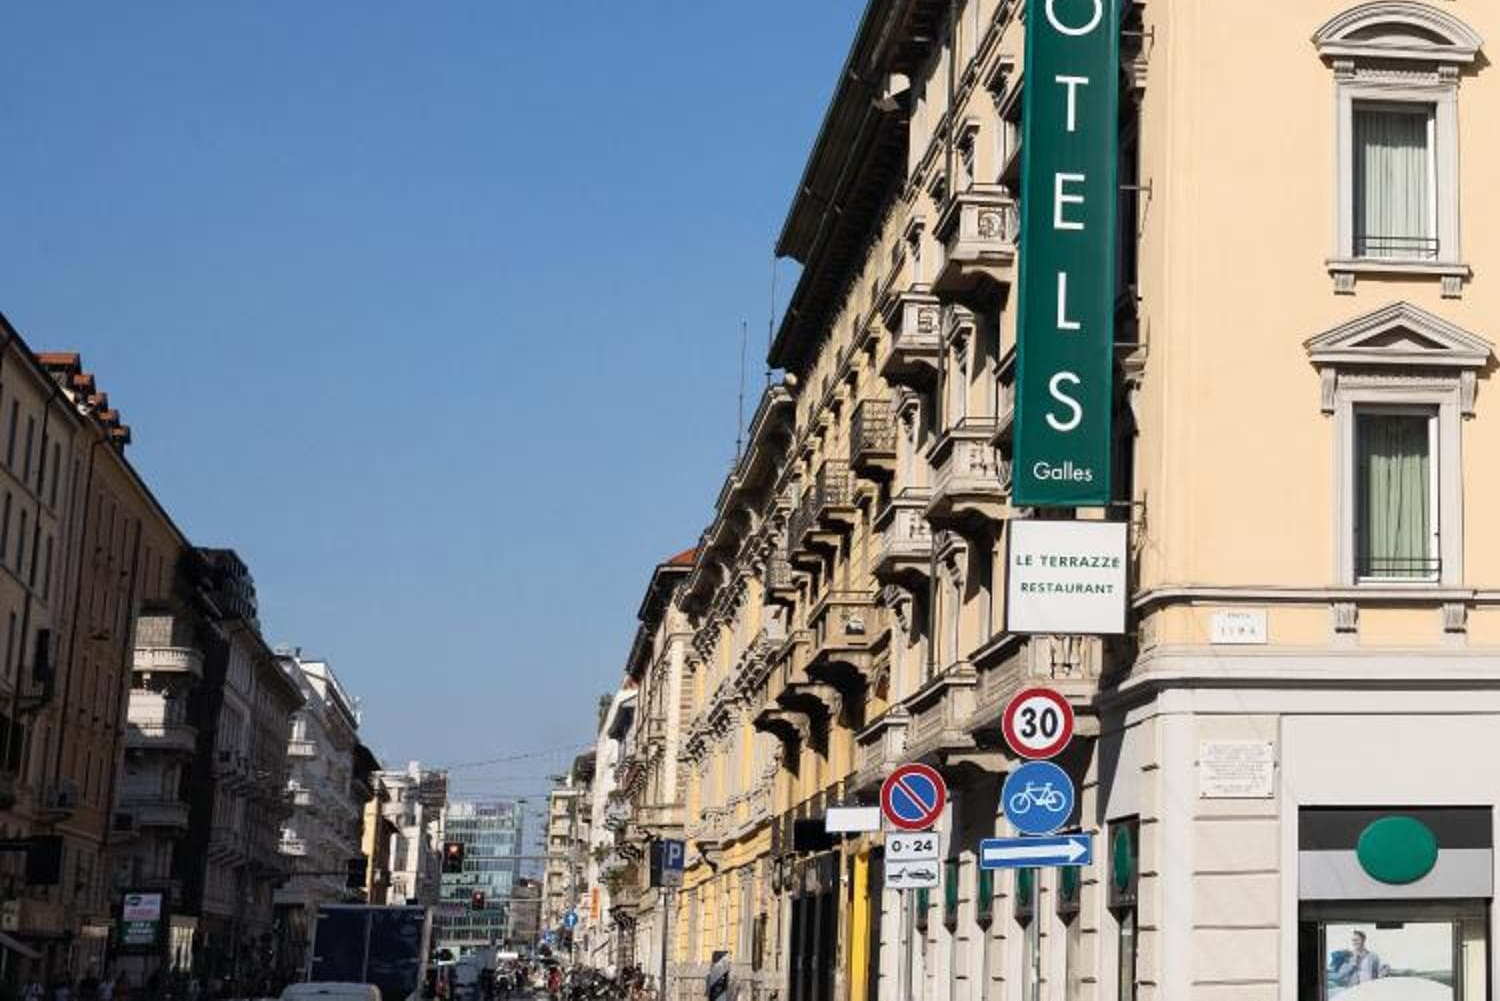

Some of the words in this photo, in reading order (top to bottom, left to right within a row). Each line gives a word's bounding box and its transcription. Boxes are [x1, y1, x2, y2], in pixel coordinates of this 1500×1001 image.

[1033, 461, 1093, 482] Galles
[1016, 555, 1033, 566] LE
[1041, 556, 1120, 568] TERRAZZE
[1021, 582, 1114, 594] RESTAURANT
[1021, 707, 1058, 738] 30
[669, 843, 681, 865] P
